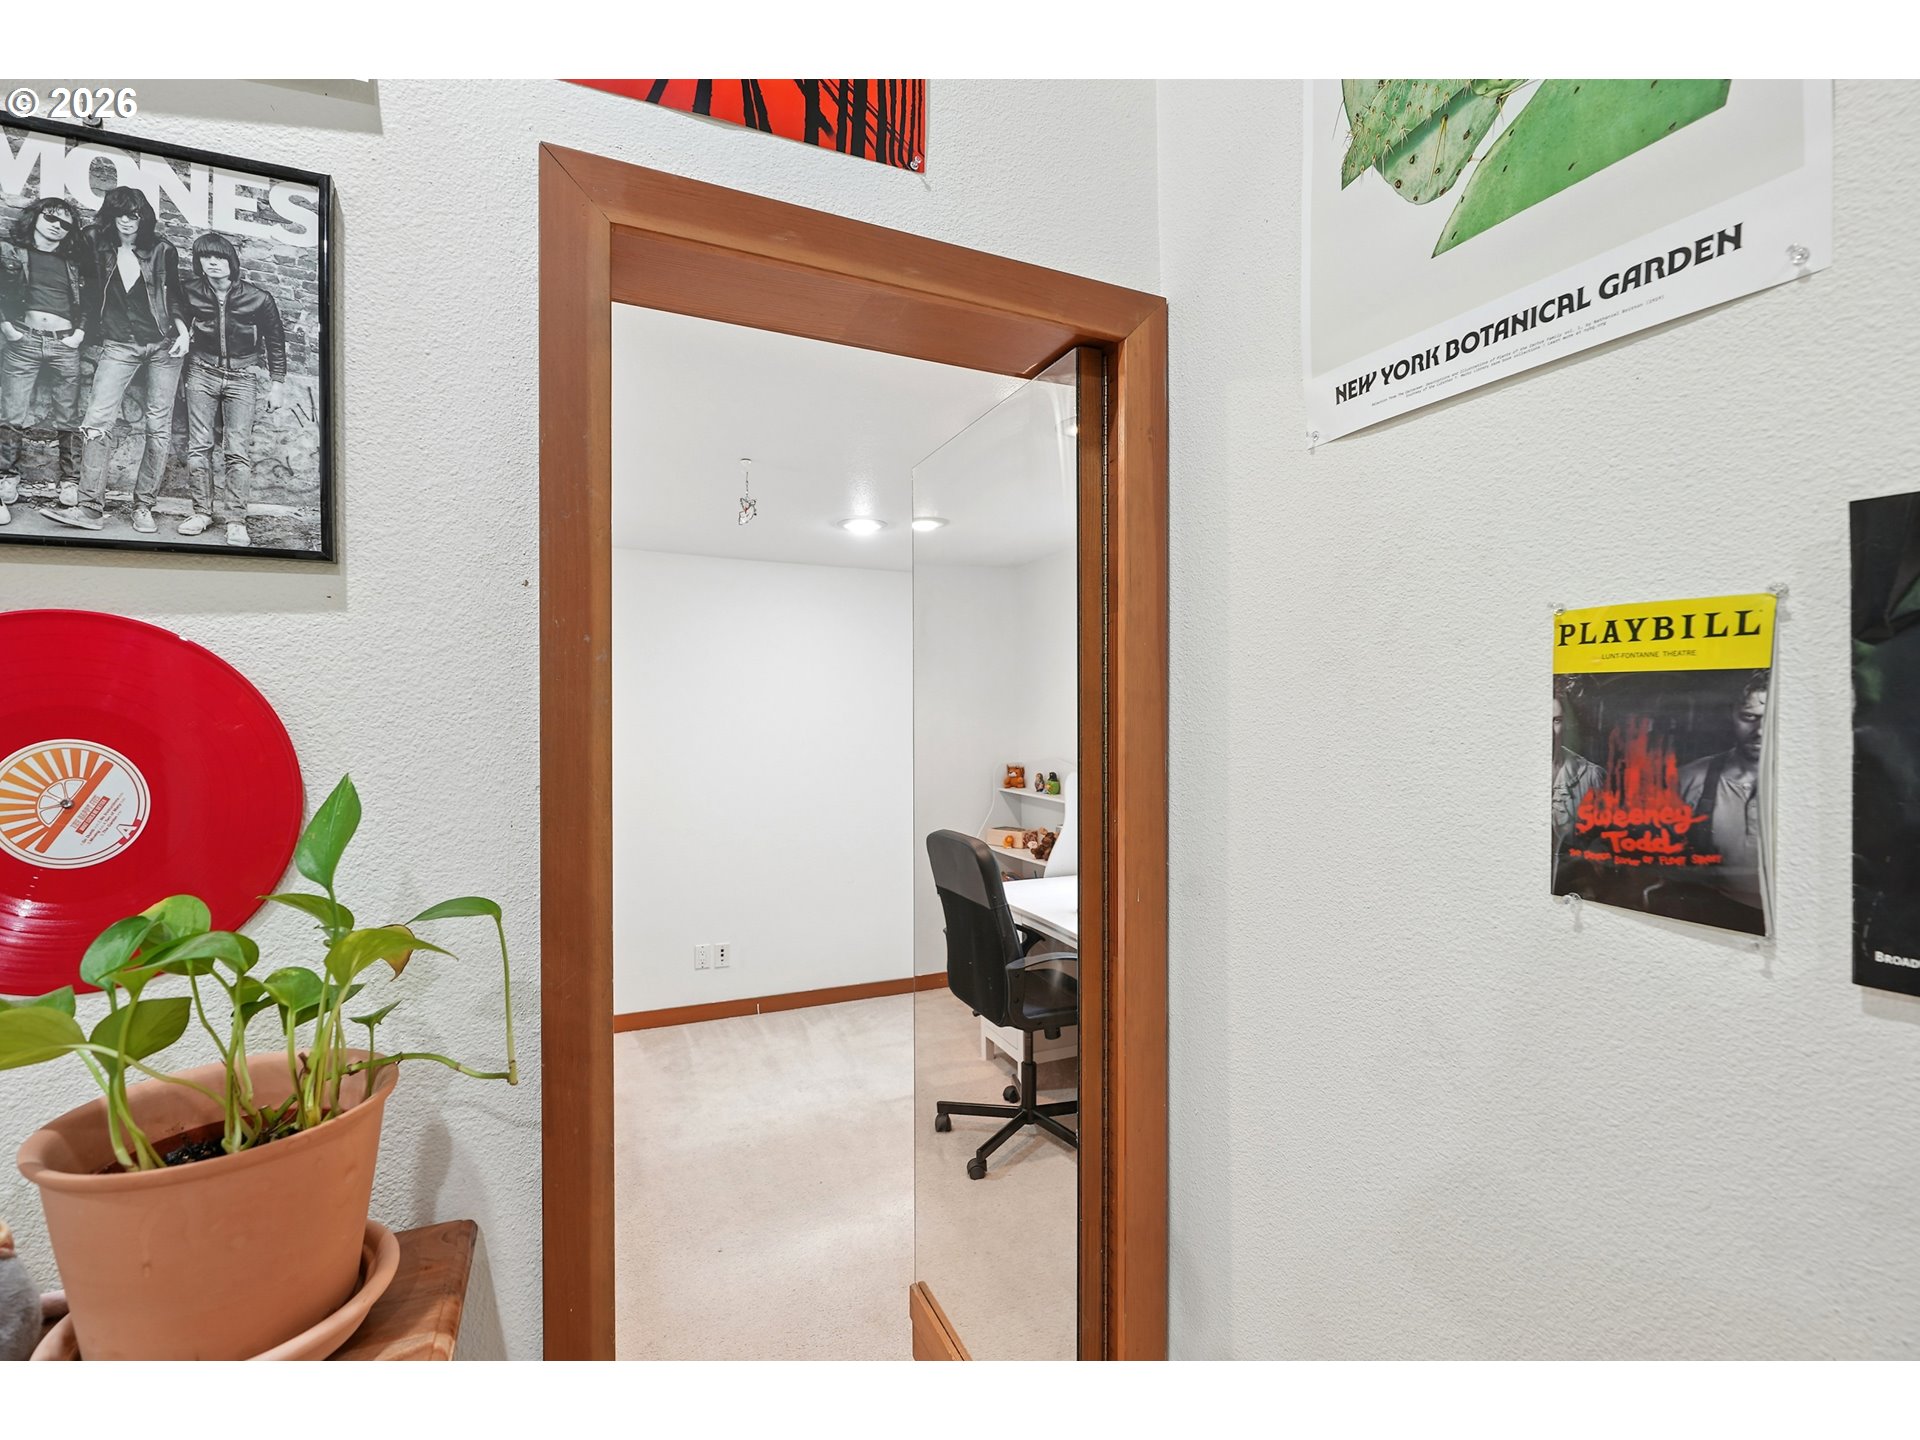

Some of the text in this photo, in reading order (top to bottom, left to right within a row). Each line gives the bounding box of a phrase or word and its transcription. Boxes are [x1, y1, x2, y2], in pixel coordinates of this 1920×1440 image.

[1335, 371, 1377, 405] NEW
[1381, 345, 1440, 386] YORK
[1445, 286, 1591, 362] BOTANICAL
[1599, 222, 1743, 300] GARDEN
[1558, 610, 1761, 647] PLAYBILL
[1601, 649, 1697, 660] LUNT-FONTANNE THEATRE
[1575, 803, 1708, 834] Sweeney
[1601, 828, 1684, 854] Todd
